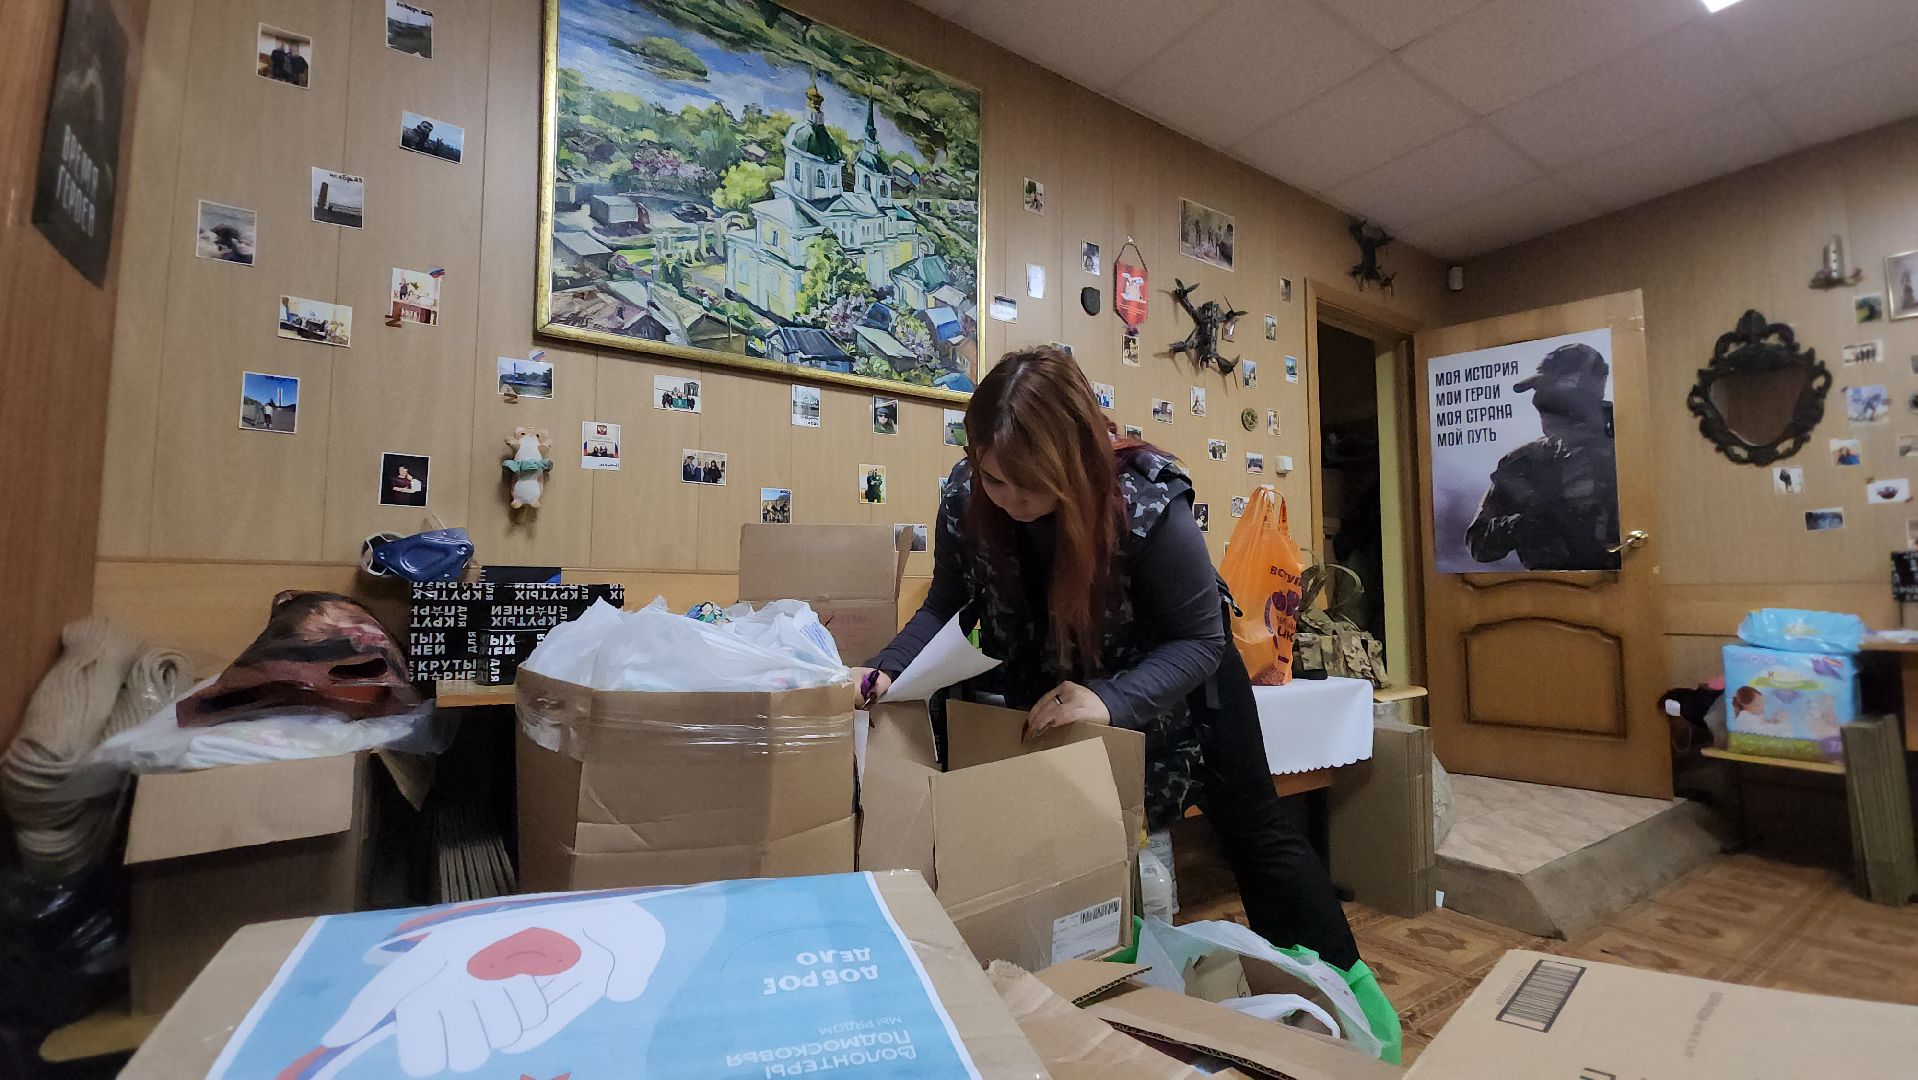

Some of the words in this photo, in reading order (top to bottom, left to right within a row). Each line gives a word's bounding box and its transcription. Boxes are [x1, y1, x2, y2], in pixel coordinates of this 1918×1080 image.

[62, 124, 99, 200] ВРЕМЯ
[56, 165, 96, 238] ГЕРОЕВ
[1435, 370, 1461, 387] МОЯ
[1464, 361, 1519, 382] ИСТОРИЯ
[1436, 390, 1461, 407] МОИ
[1465, 384, 1501, 402] ГЕРОИ
[1436, 411, 1462, 427] МОЯ
[1466, 404, 1513, 423] СТРАНА
[1437, 428, 1463, 447] МОЙ
[1467, 428, 1497, 444] ПУТЬ
[515, 590, 579, 600] КРУТЫХ
[491, 616, 557, 627] КРУТЫХ
[795, 947, 871, 967] ДЕЛО
[762, 964, 879, 996] ДОБРОЕ
